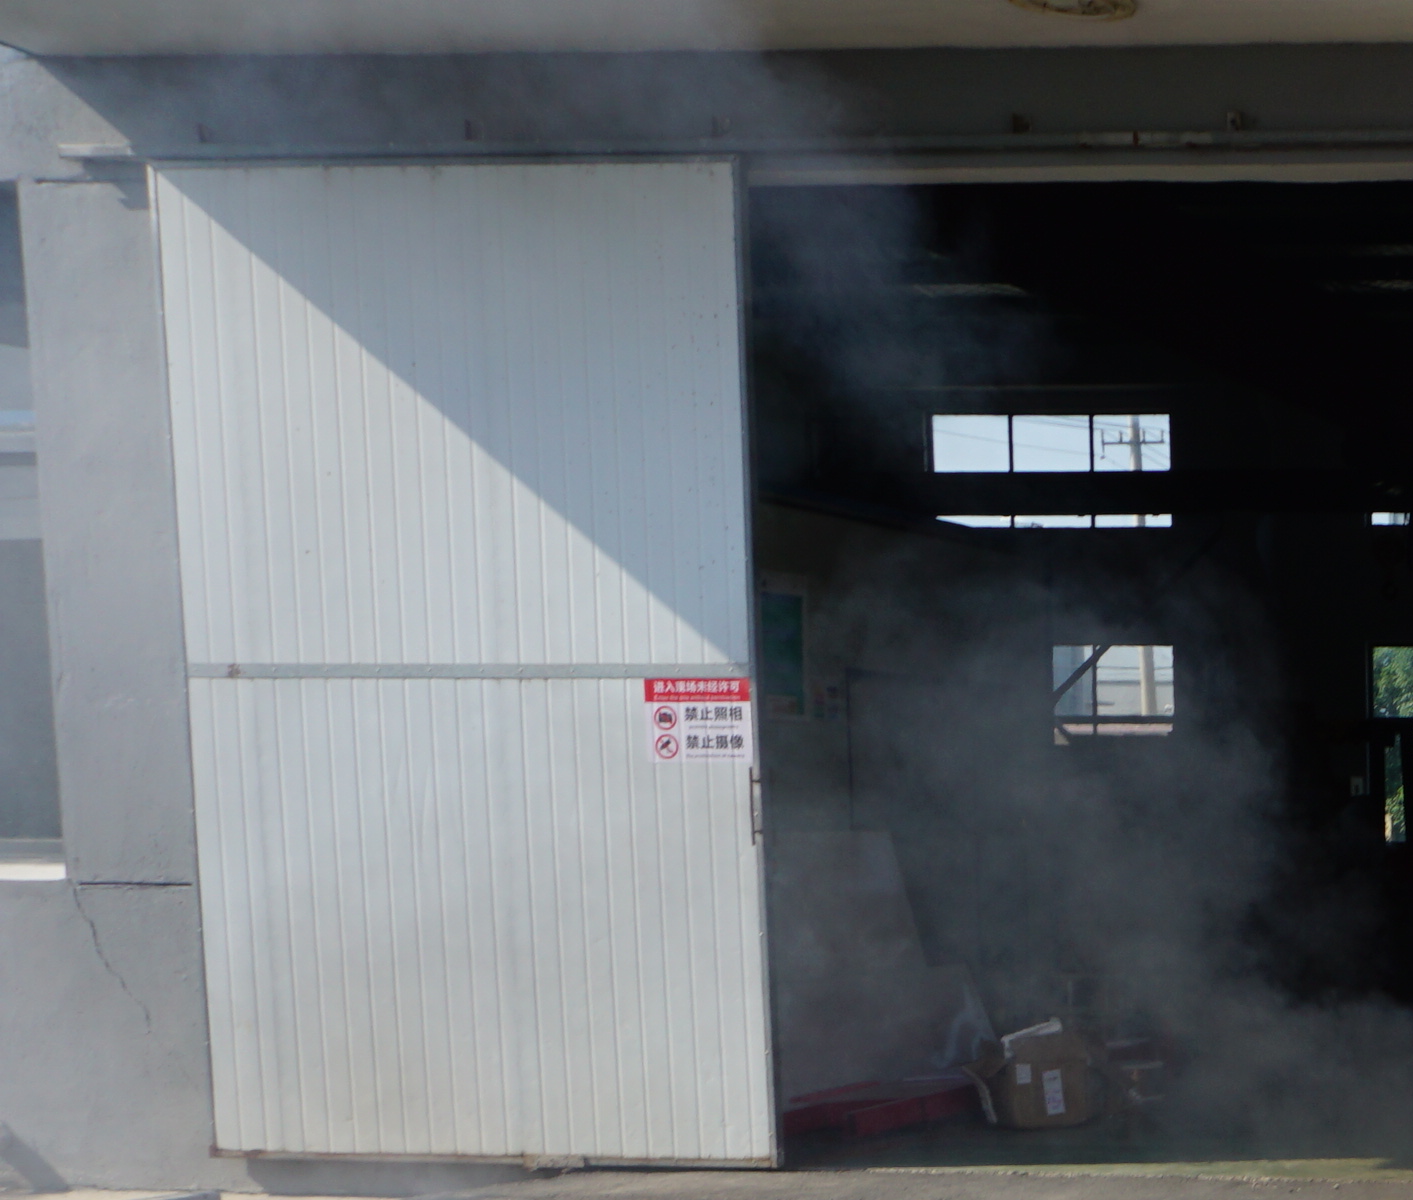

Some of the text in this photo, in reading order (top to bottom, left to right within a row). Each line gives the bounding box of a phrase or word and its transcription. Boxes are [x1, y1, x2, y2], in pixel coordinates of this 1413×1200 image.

[684, 705, 743, 721] 禁止照相
[685, 734, 745, 750] 禁止摄像
